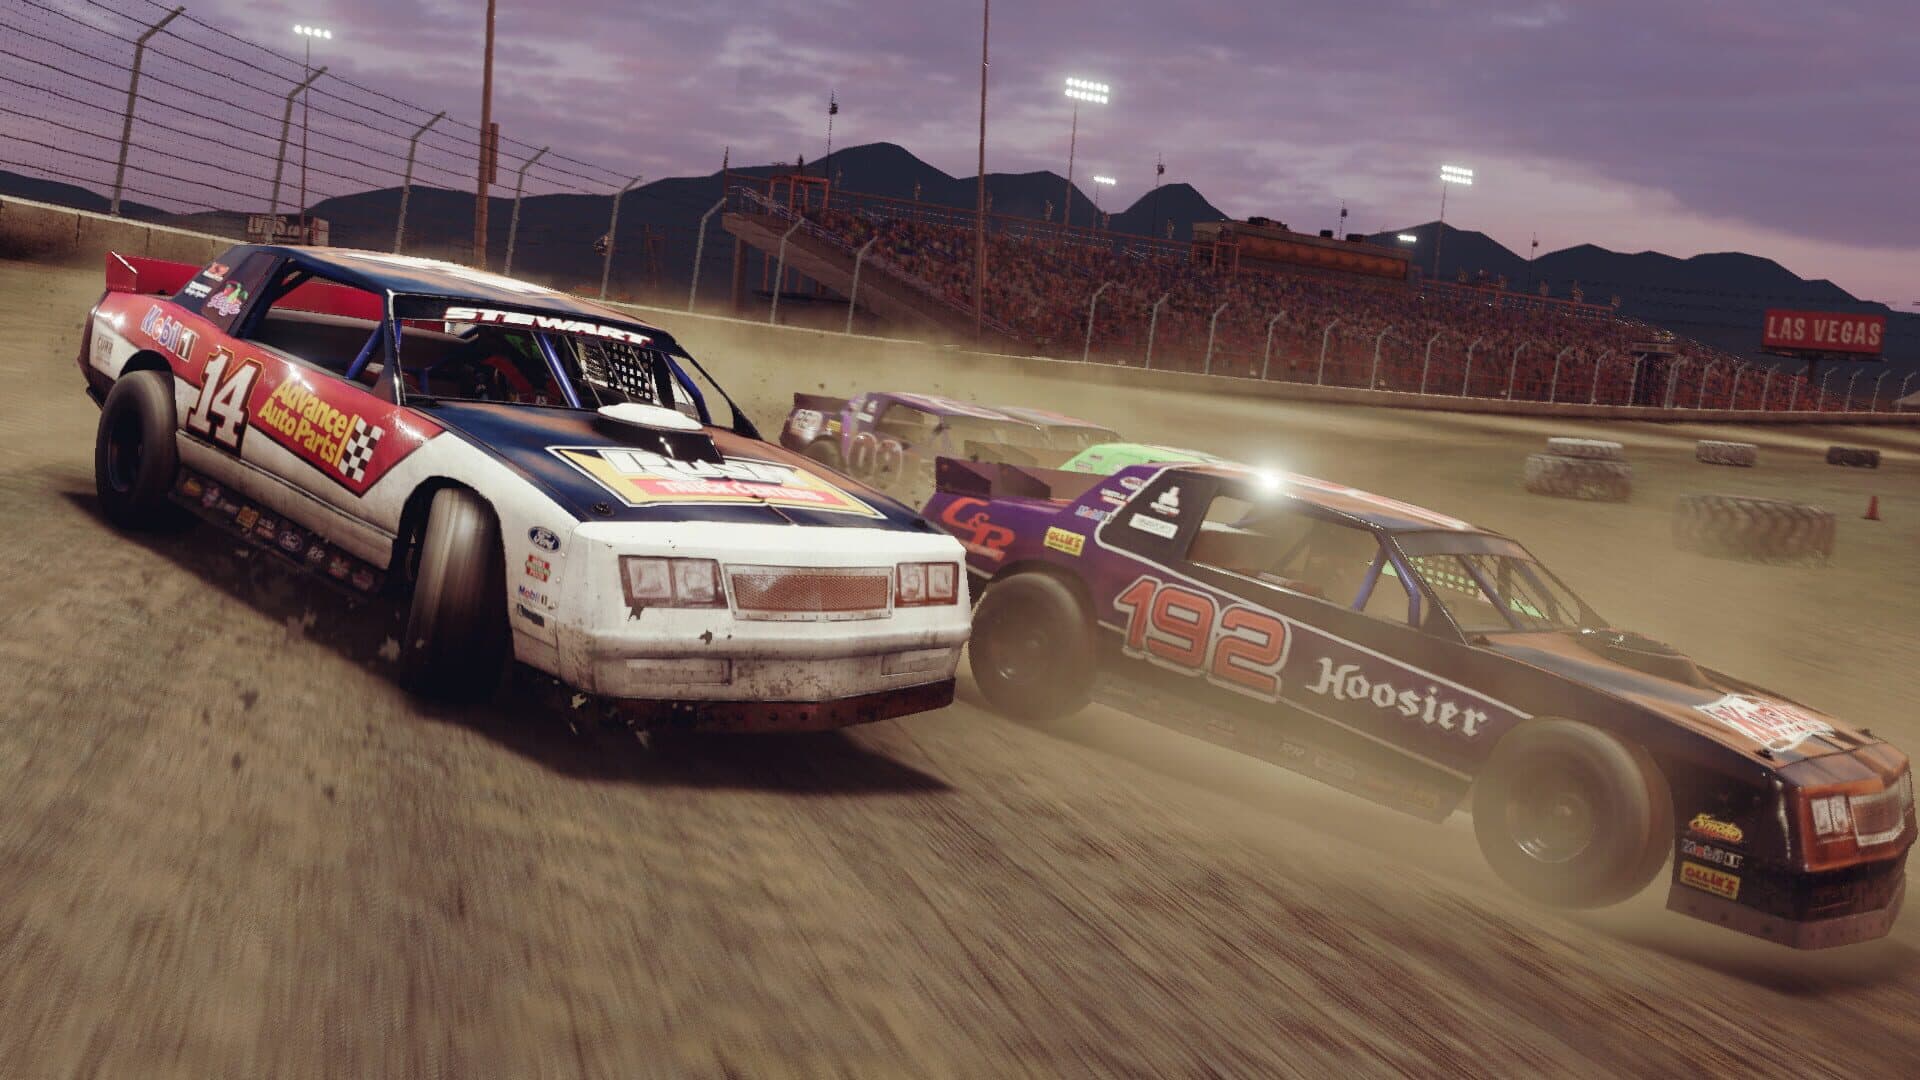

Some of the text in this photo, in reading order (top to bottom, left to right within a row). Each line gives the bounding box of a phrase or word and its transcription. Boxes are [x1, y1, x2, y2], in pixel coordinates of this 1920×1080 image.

[140, 304, 183, 354] Mobil
[443, 306, 654, 347] STEWART
[1767, 316, 1882, 347] LAS VEGAS
[188, 348, 263, 457] 14
[258, 398, 338, 463] Auto Parts
[271, 376, 348, 439] Advance
[1113, 575, 1292, 703] 192
[1305, 656, 1488, 737] Hoosier
[1684, 866, 1738, 893] OLLIE'S
